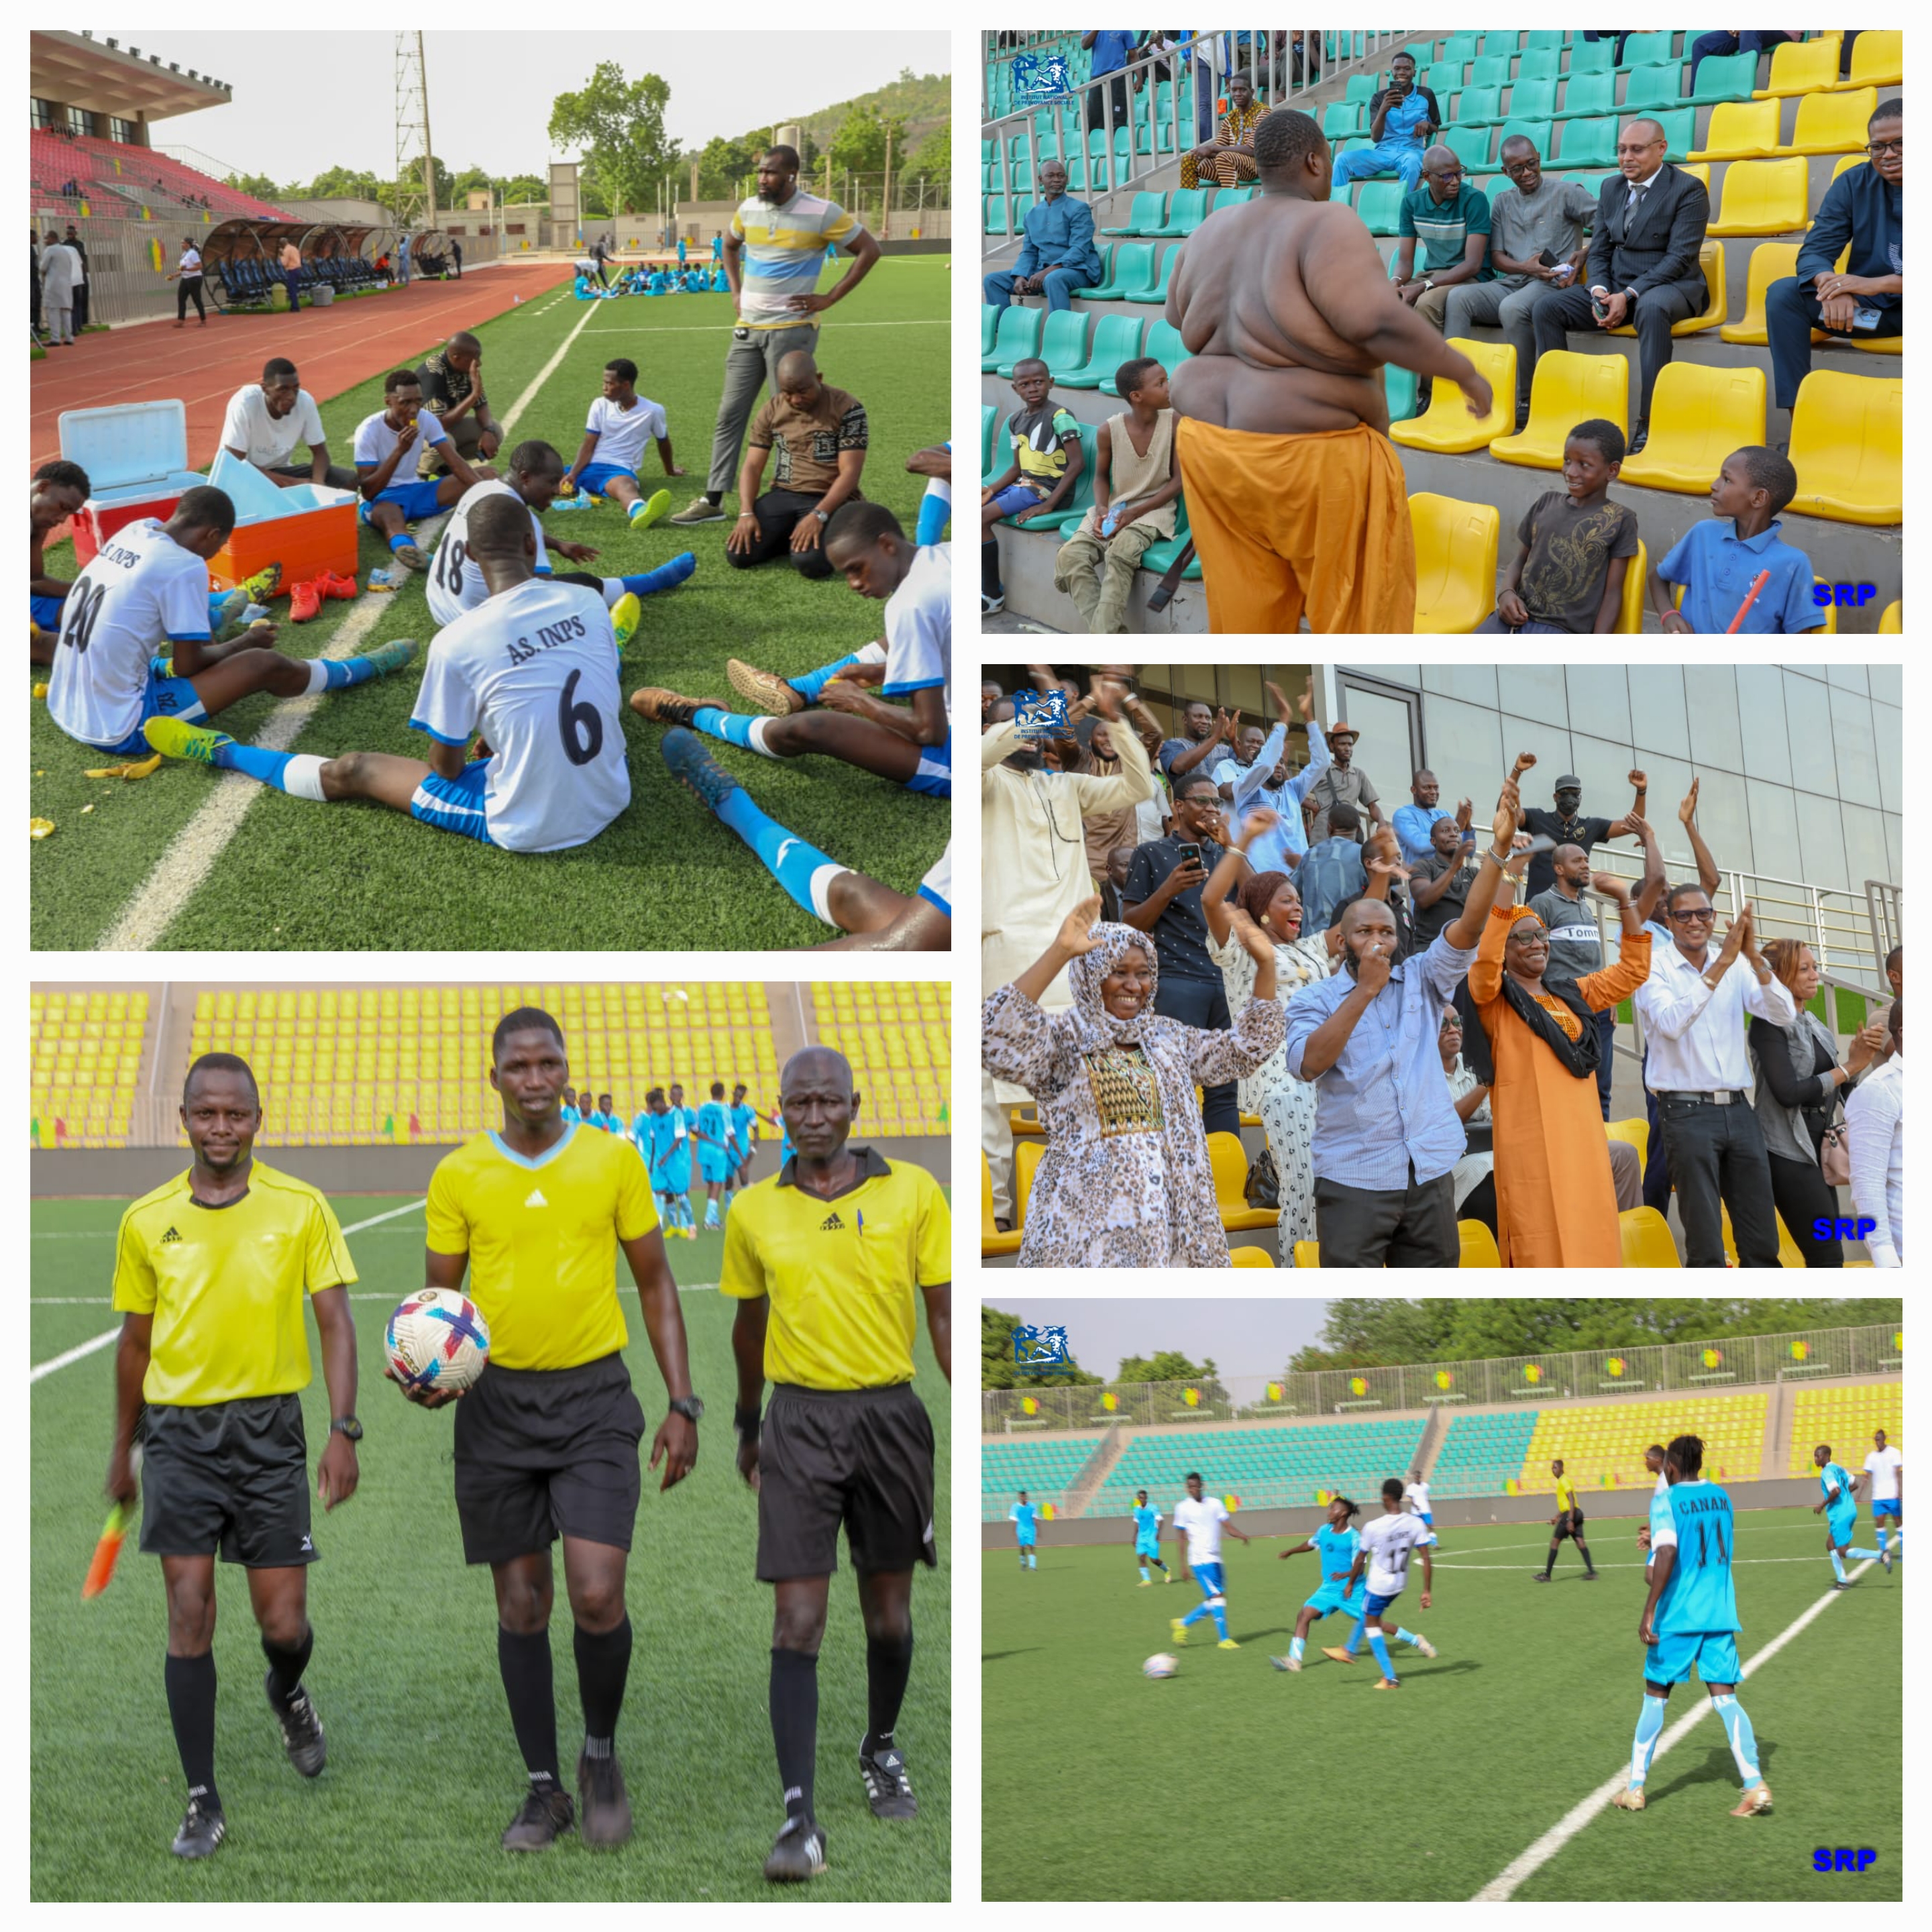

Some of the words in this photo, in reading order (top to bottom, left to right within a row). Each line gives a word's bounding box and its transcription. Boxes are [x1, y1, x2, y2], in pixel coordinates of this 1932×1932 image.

[436, 532, 466, 596] 18
[63, 576, 106, 654] 20
[506, 637, 541, 666] AS.
[535, 615, 586, 648] INPS
[558, 669, 603, 765] 6
[1679, 1496, 1730, 1515] CANAM
[1696, 1517, 1728, 1568] 11
